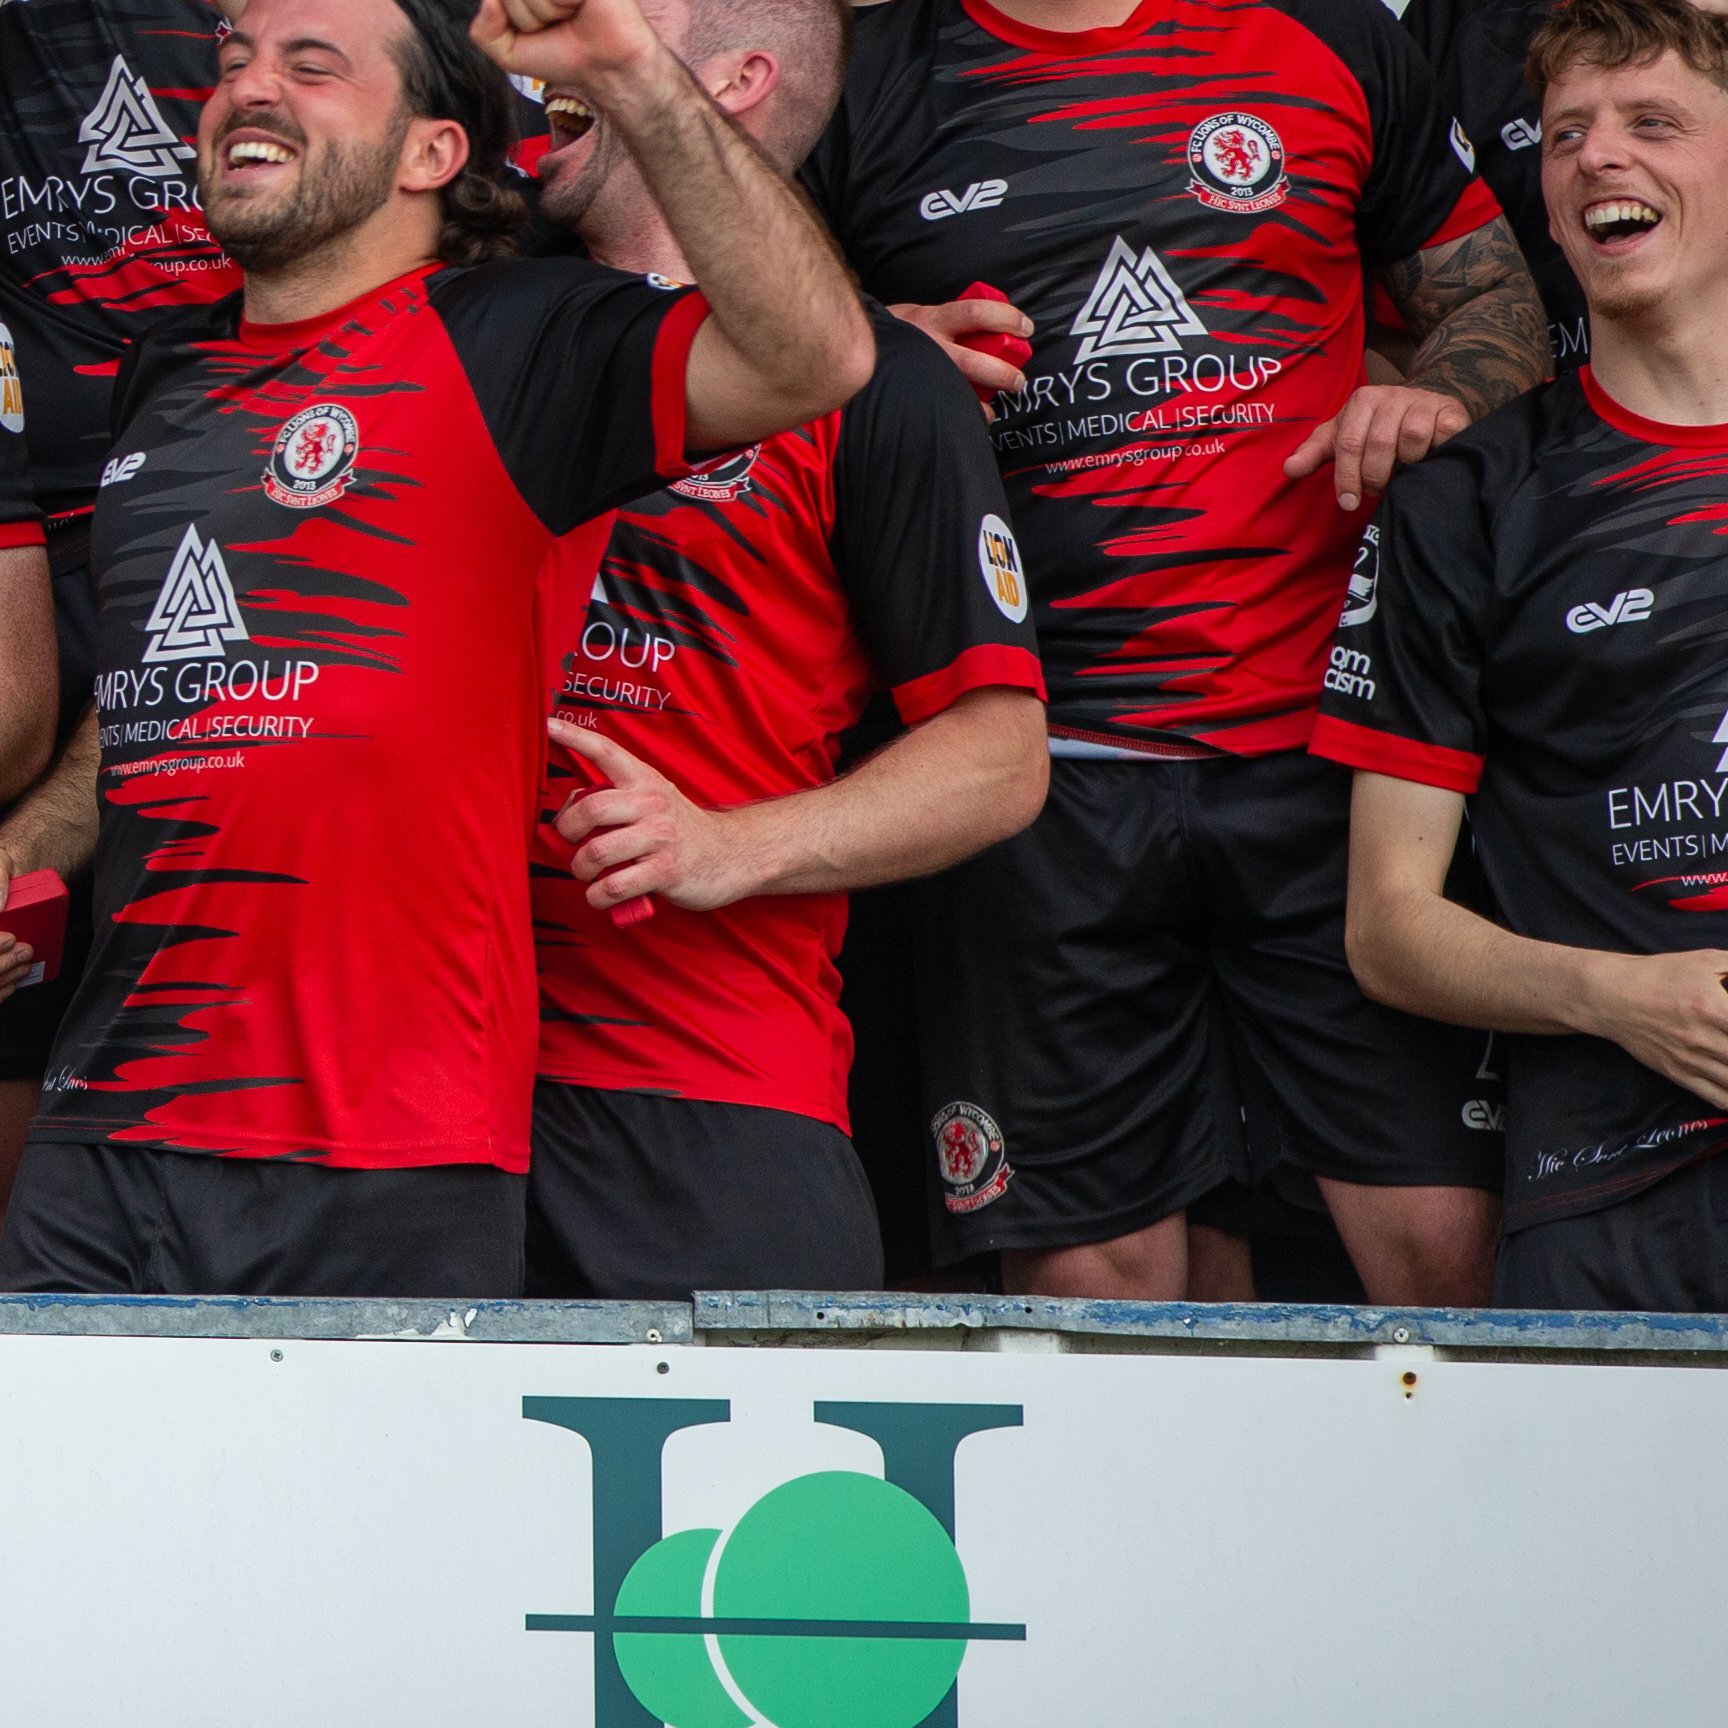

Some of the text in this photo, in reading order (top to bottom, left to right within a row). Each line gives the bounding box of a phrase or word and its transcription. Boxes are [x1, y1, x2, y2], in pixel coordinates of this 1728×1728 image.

[1191, 114, 1280, 153] FC LIONS OF WYCOMBE
[1, 175, 116, 219] EMRYS
[1230, 186, 1254, 197] 2013
[1126, 353, 1282, 396] GROUP
[315, 406, 330, 416] OF
[174, 659, 320, 703] GROUP
